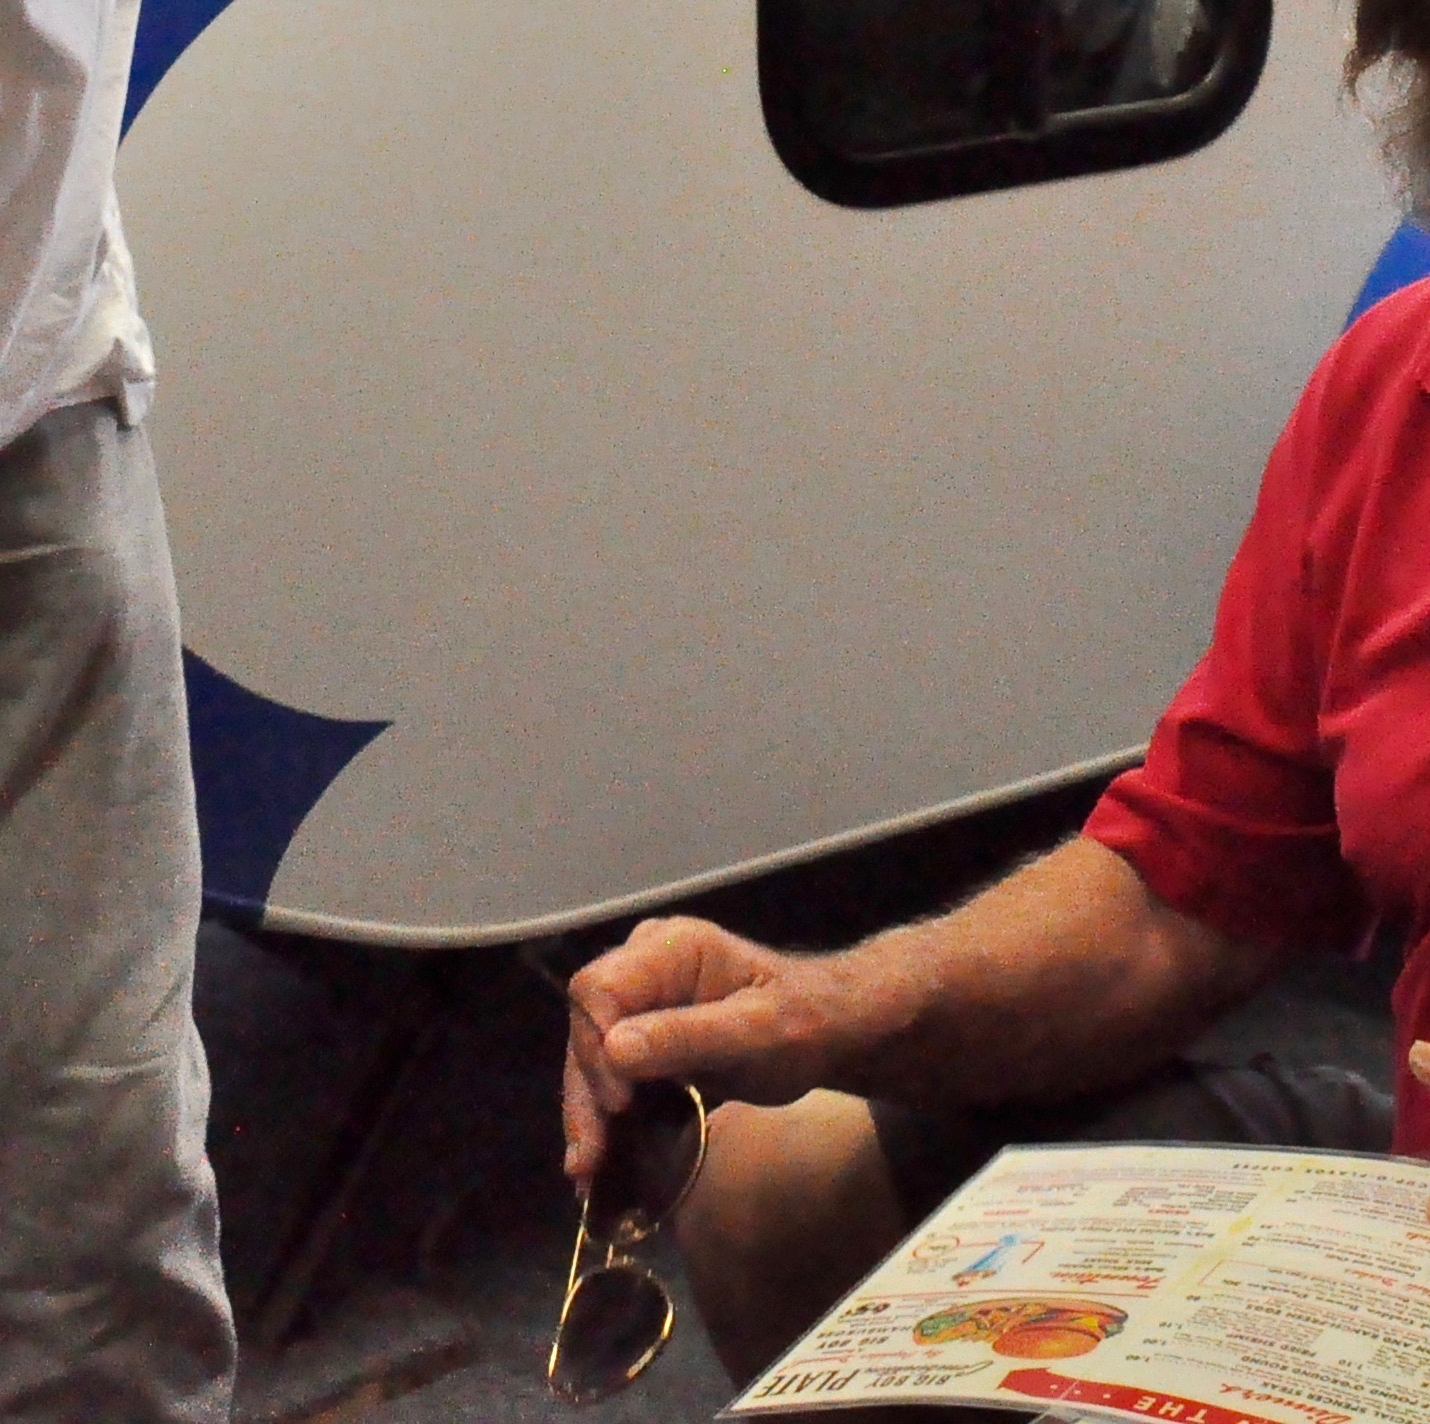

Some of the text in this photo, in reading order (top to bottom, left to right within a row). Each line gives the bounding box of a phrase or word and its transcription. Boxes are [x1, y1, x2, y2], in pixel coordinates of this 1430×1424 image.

[1241, 1355, 1288, 1372] ROUND
[753, 1369, 950, 1399] BIG BOY PLATE
[1261, 1381, 1303, 1396] STEAK
[1305, 1393, 1368, 1414] SPENCER
[1369, 1388, 1419, 1406] POUND
[1132, 1396, 1207, 1424] THE
